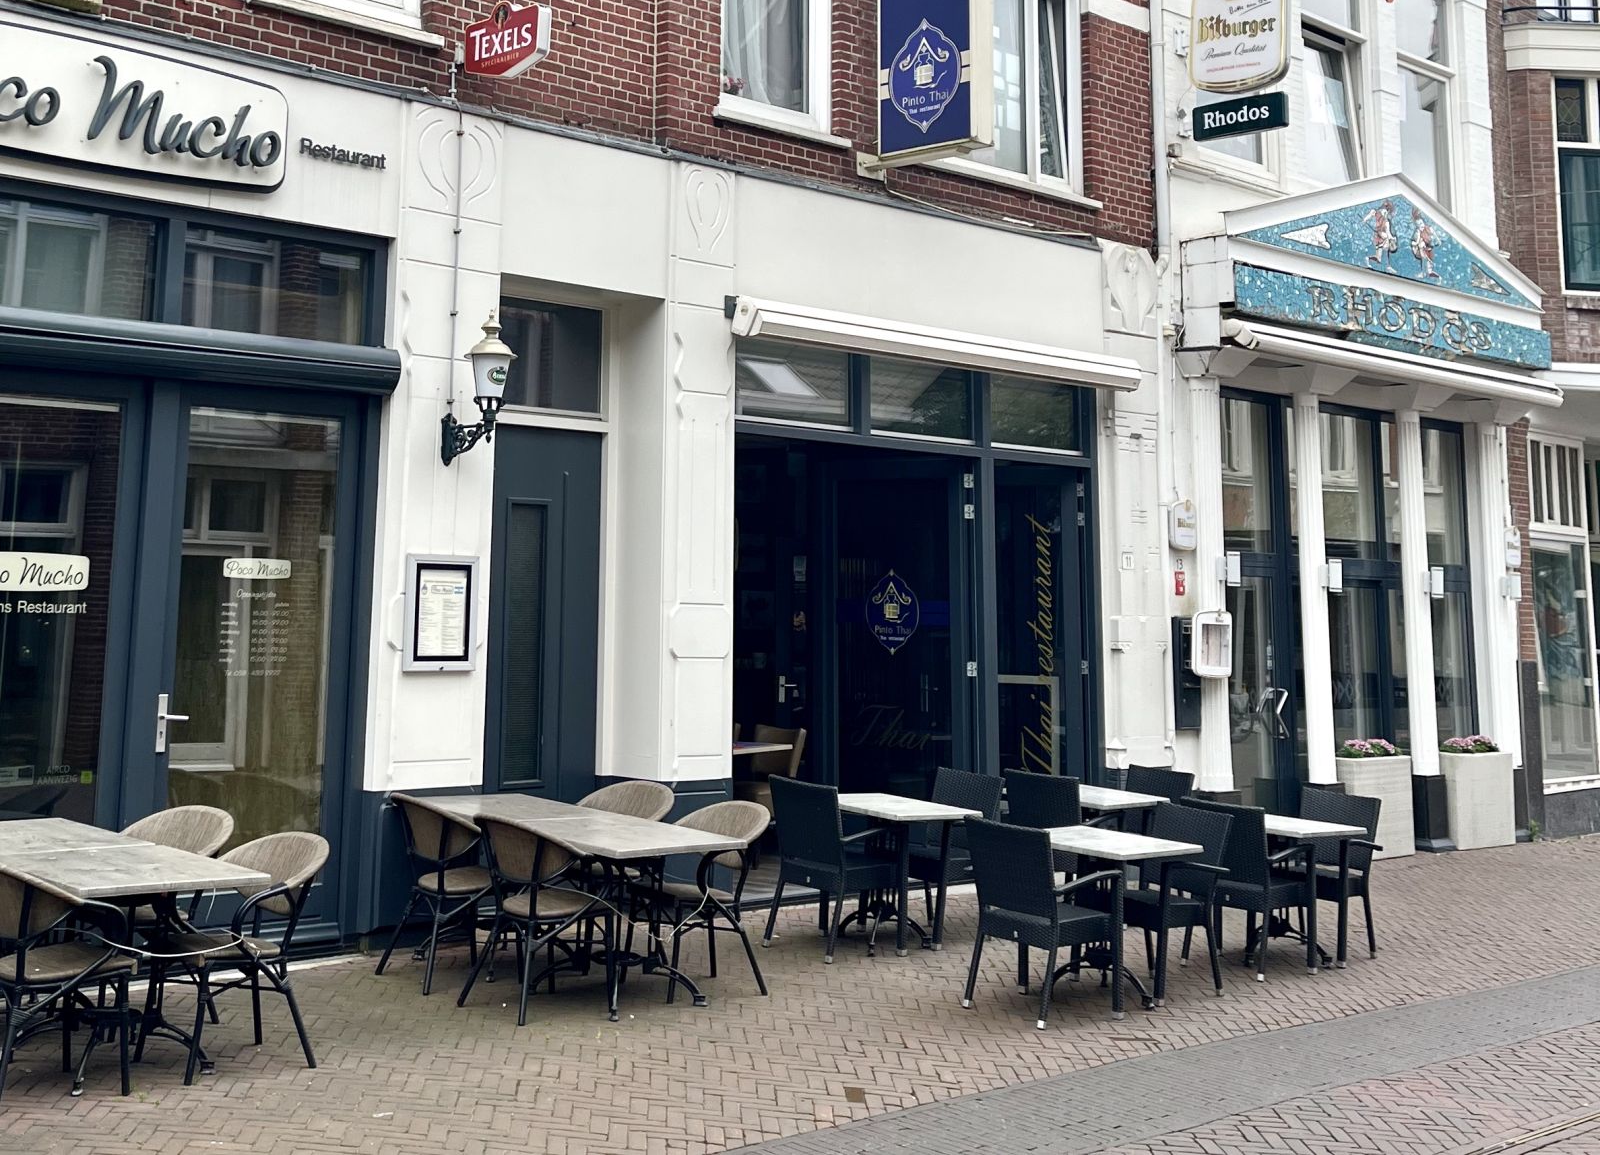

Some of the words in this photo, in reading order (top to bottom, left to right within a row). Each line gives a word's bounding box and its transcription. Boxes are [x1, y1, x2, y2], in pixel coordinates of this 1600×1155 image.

[470, 23, 532, 62] TEXELS
[1197, 14, 1277, 44] Bitburger
[87, 55, 282, 168] Mucho
[902, 96, 926, 108] Pinto
[928, 89, 950, 103] Thai
[1203, 104, 1270, 130] Rhodos
[299, 136, 387, 170] Restaurant
[1306, 285, 1492, 352] RHODOS
[19, 556, 85, 587] Mucho
[226, 560, 254, 576] Poco
[257, 560, 289, 577] Mucho
[1176, 558, 1184, 570] 13
[17, 600, 88, 614] Restaurant
